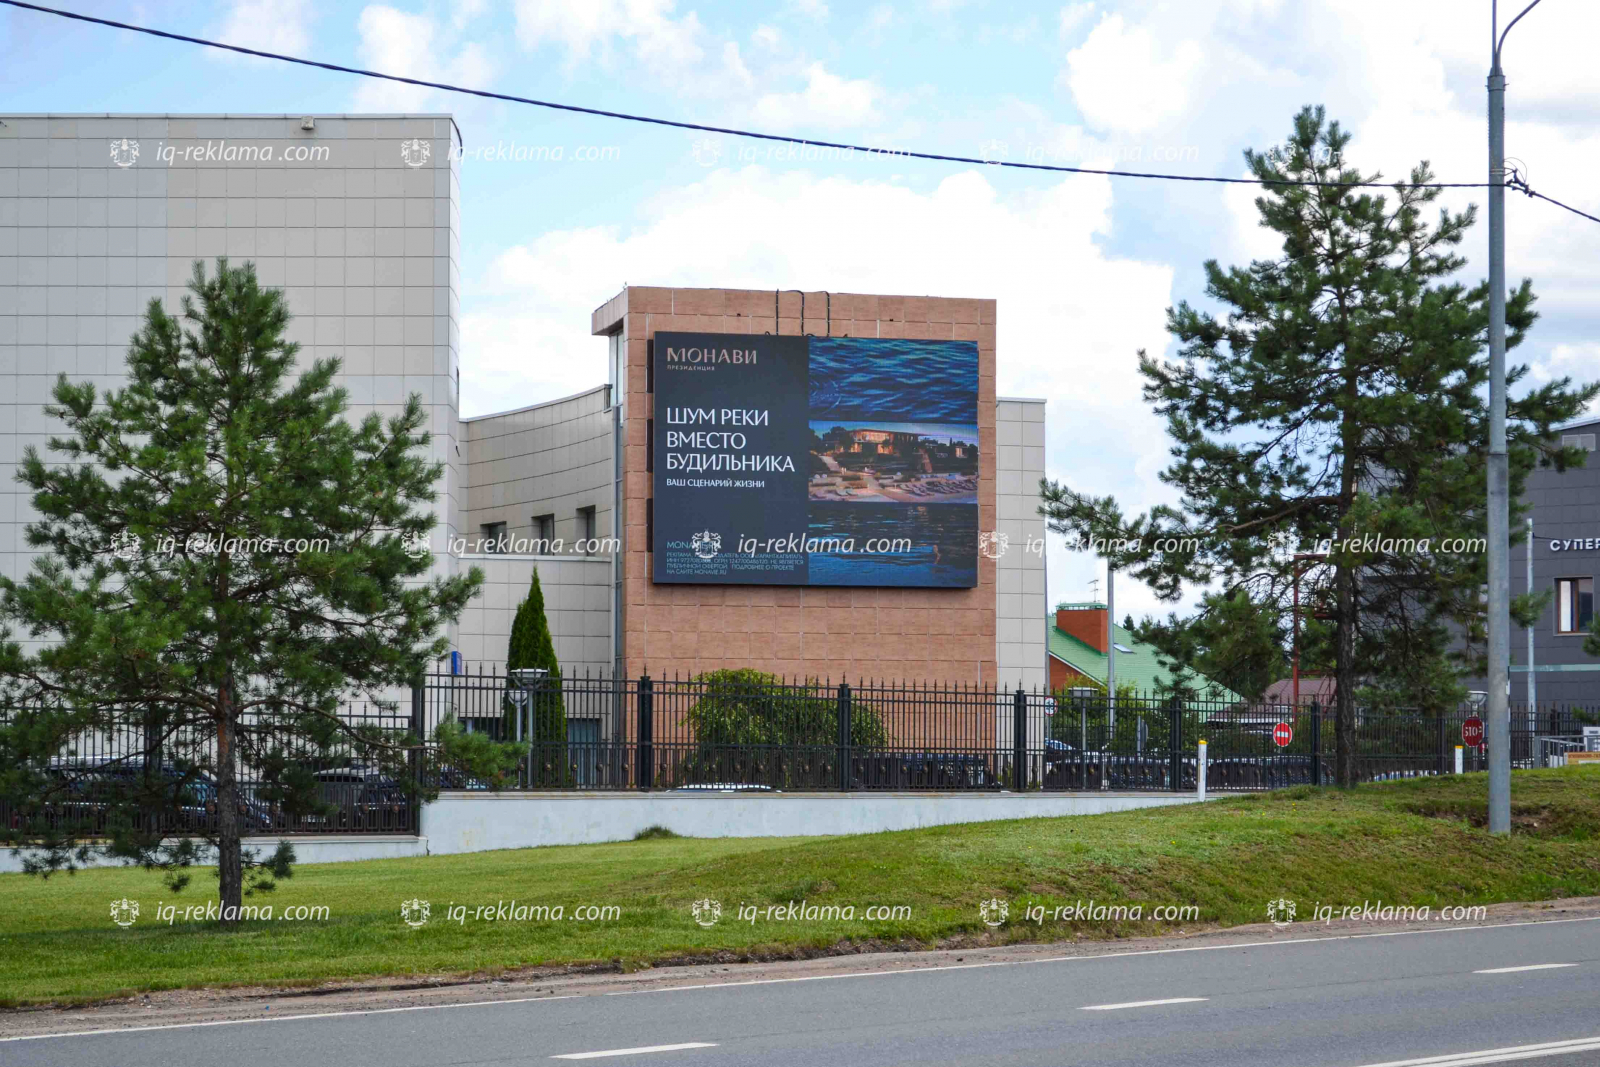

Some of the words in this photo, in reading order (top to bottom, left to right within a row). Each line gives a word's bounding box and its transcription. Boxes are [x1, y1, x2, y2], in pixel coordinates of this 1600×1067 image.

[666, 347, 757, 364] МОНАВИ
[667, 407, 715, 425] ШУМ
[721, 409, 769, 426] РЕКИ
[667, 431, 746, 449] ВМЕСТО
[667, 453, 795, 473] БУДИЛЬНИКА
[687, 478, 733, 488] СЦЕНАРИЙ
[734, 480, 765, 488] ЖИЗНИ
